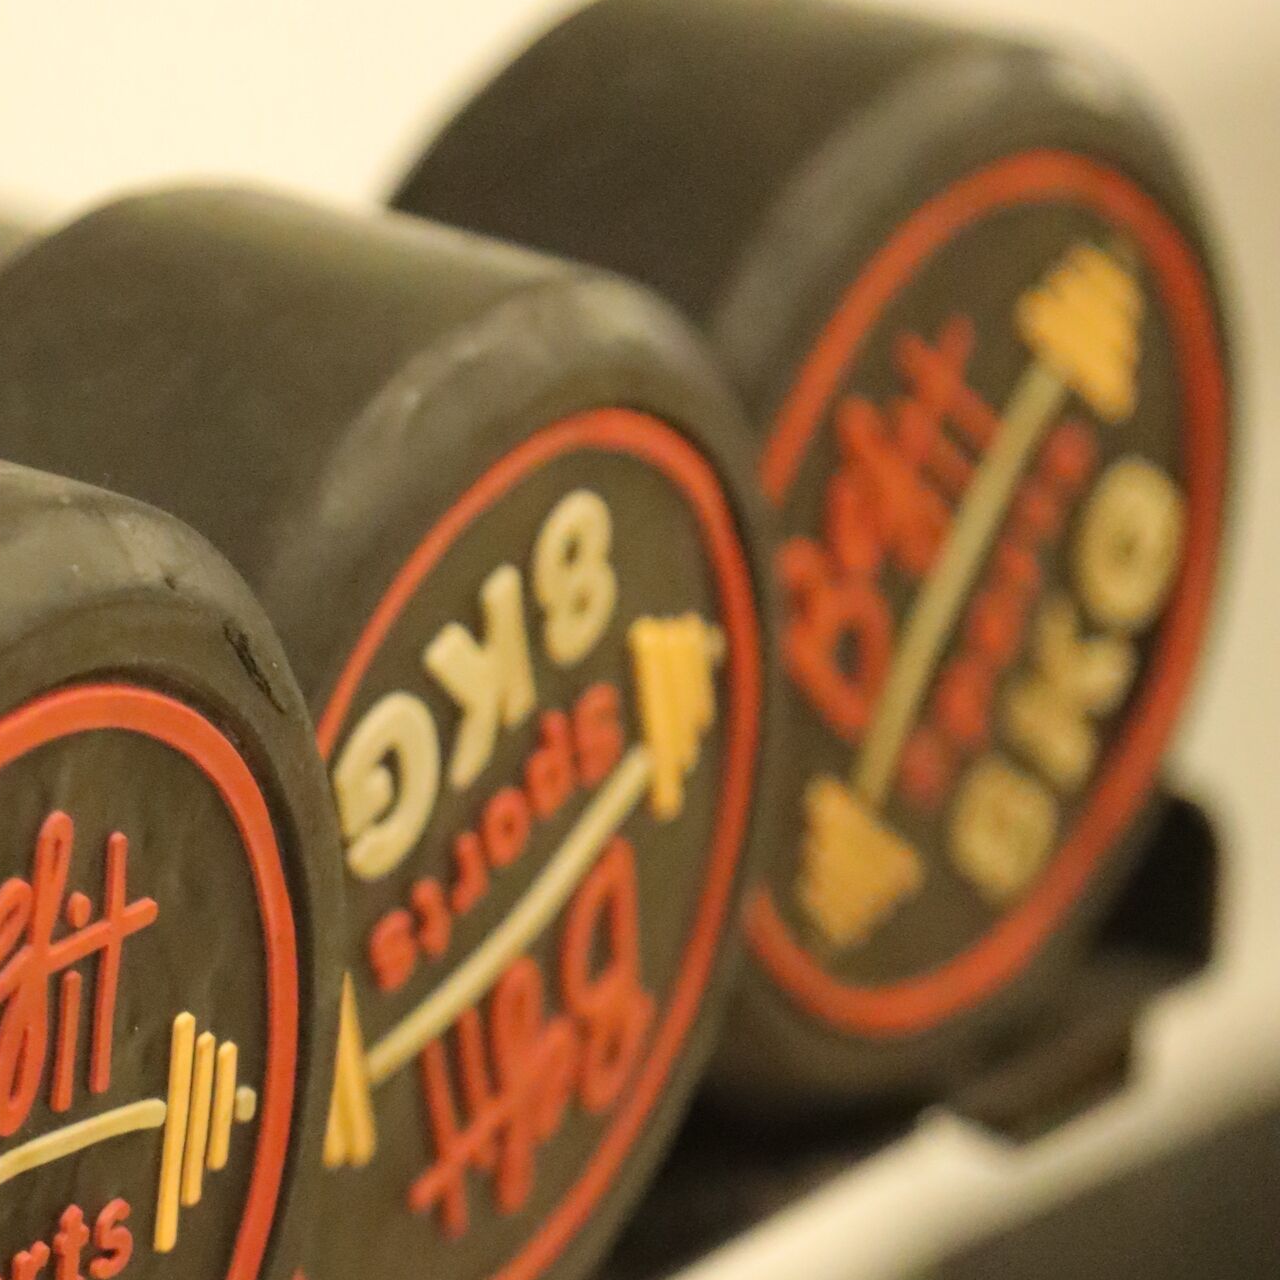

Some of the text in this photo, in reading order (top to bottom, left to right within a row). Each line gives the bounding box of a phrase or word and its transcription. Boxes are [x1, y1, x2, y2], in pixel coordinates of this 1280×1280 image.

[333, 488, 617, 880] 8KG
[370, 683, 625, 992] Sports
[407, 836, 656, 1238] Befit
